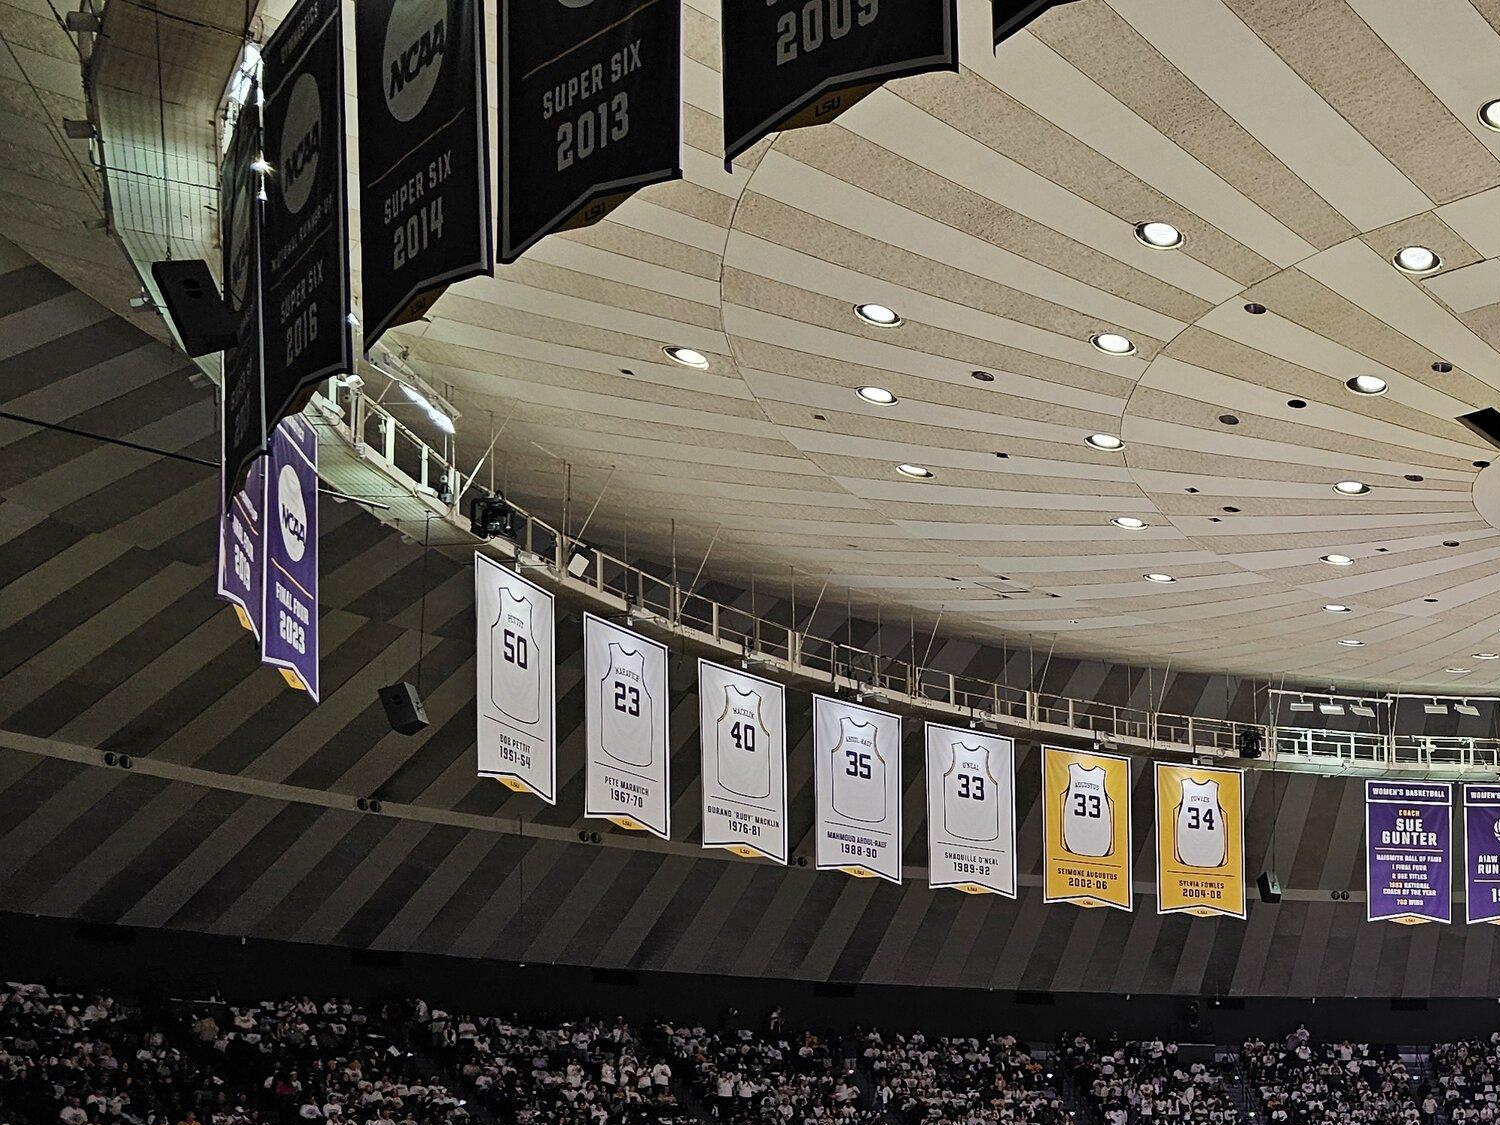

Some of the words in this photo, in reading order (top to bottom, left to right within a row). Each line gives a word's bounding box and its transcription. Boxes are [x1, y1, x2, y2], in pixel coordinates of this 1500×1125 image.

[389, 18, 447, 100] NCAA
[543, 70, 603, 120] SUPER
[611, 39, 643, 83] SIX
[814, 96, 841, 117] LSU
[557, 91, 629, 172] 2013
[384, 171, 424, 225] SUPER
[429, 150, 451, 188] SIX
[394, 196, 443, 271] 2014
[280, 278, 306, 325] SUPER
[308, 258, 323, 293] SIX
[286, 302, 318, 367] 2016
[282, 504, 306, 548] NCAA
[276, 581, 293, 611] FINAL
[293, 595, 310, 626] FOUR
[279, 610, 306, 655] 2023
[503, 628, 528, 670] 50
[614, 680, 640, 718] 23
[500, 733, 511, 747] BOB
[512, 739, 531, 755] PETTIT
[730, 721, 755, 752] 40
[499, 744, 531, 769] 1951-54
[846, 750, 871, 780] 35
[604, 775, 618, 789] PETE
[620, 780, 649, 797] MARAVICH
[610, 787, 643, 808] 1967-70
[957, 773, 985, 801] 33
[1372, 787, 1404, 796] WOMEN'S
[1405, 789, 1445, 798] BASKETBALL
[707, 805, 732, 819] DURAND
[754, 815, 780, 828] MACKLIN
[1074, 793, 1101, 818] 33
[1398, 809, 1420, 817] COACH
[728, 819, 761, 837] 1976-81
[1187, 807, 1215, 831] 34
[1395, 818, 1423, 832] SUE
[827, 830, 855, 843] MAHMOUD
[856, 834, 887, 848] ABDUL-RAUF
[1381, 830, 1437, 846] GUNTER
[840, 842, 877, 859] 1988-90
[944, 851, 977, 863] SHAQUILLE
[978, 856, 999, 866] O'NEAL
[954, 861, 990, 876] 1989-92
[1057, 867, 1085, 877] SEIMONE
[1086, 870, 1118, 881] AUGUSTUS
[1068, 877, 1108, 890] 2002-06
[1178, 880, 1200, 888] SYLVIA
[1200, 881, 1225, 889] FOWLES
[1182, 888, 1221, 899] 2004-08
